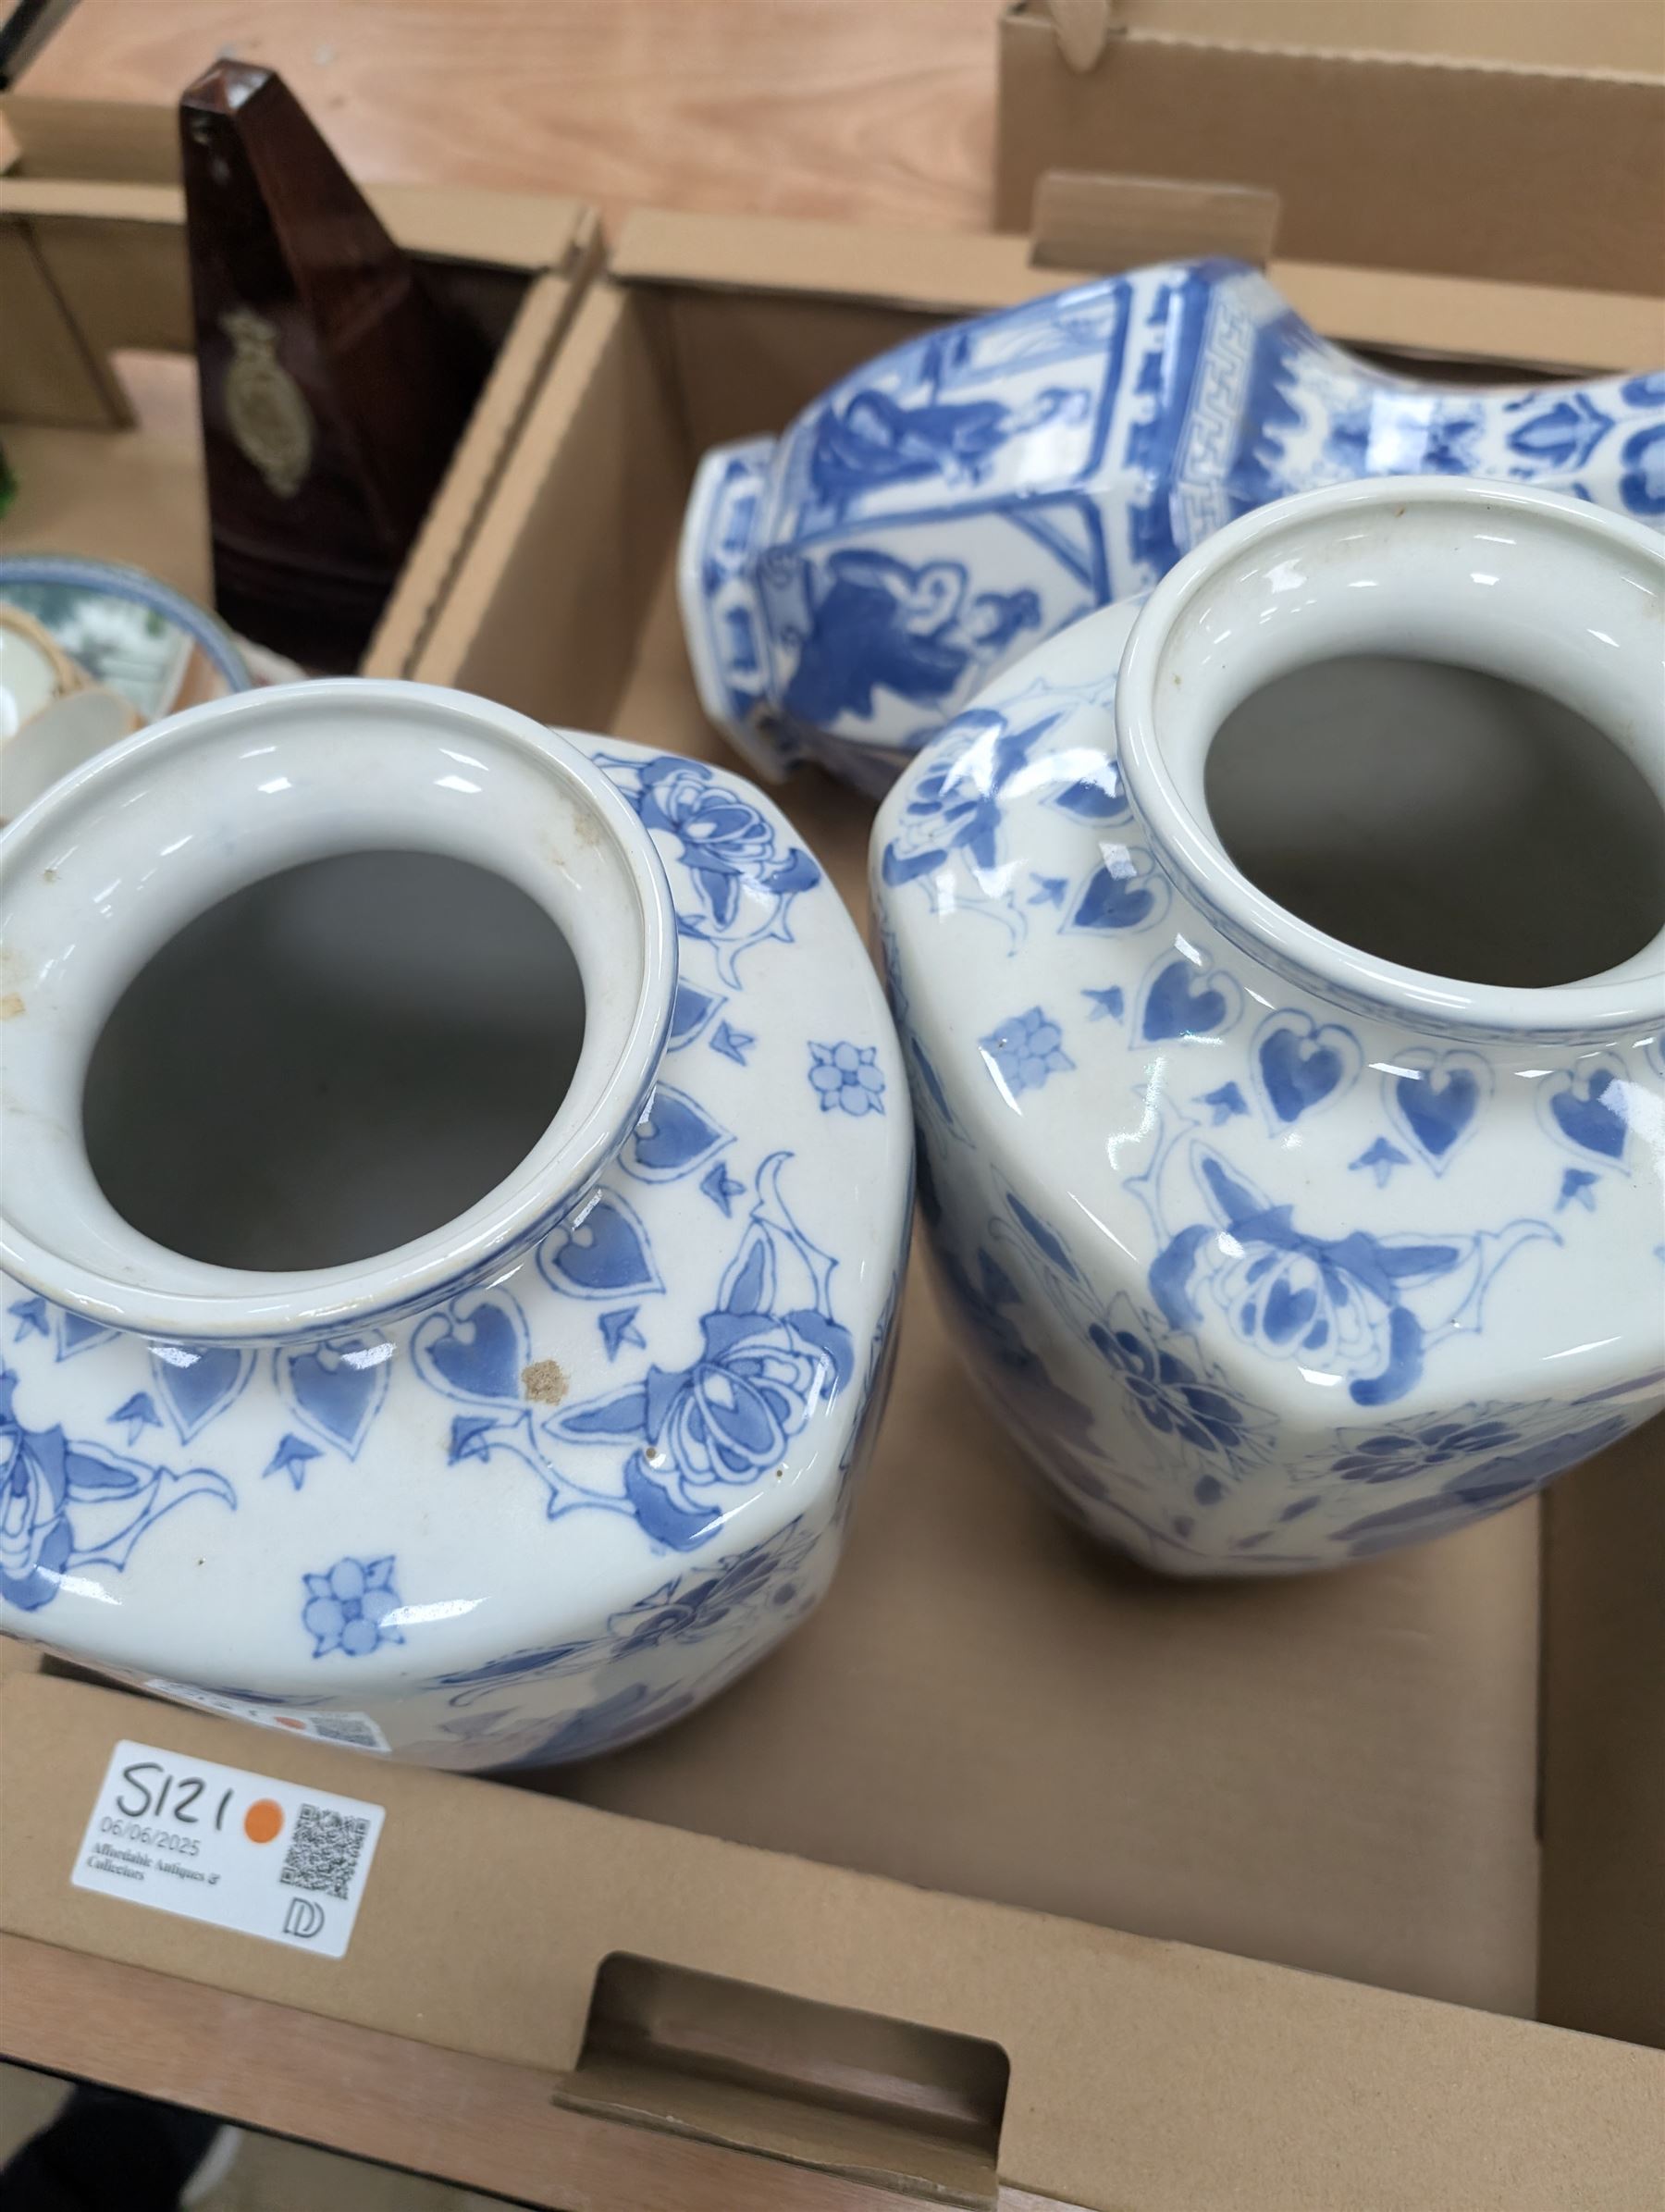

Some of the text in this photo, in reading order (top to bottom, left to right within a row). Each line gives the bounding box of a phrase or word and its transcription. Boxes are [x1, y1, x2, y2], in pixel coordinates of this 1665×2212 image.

[116, 1761, 233, 1831] S121
[100, 1816, 201, 1857] 06/06/2025
[87, 1856, 144, 1880] Collectors
[94, 1842, 152, 1867] Affordable
[155, 1859, 204, 1880] Antiques
